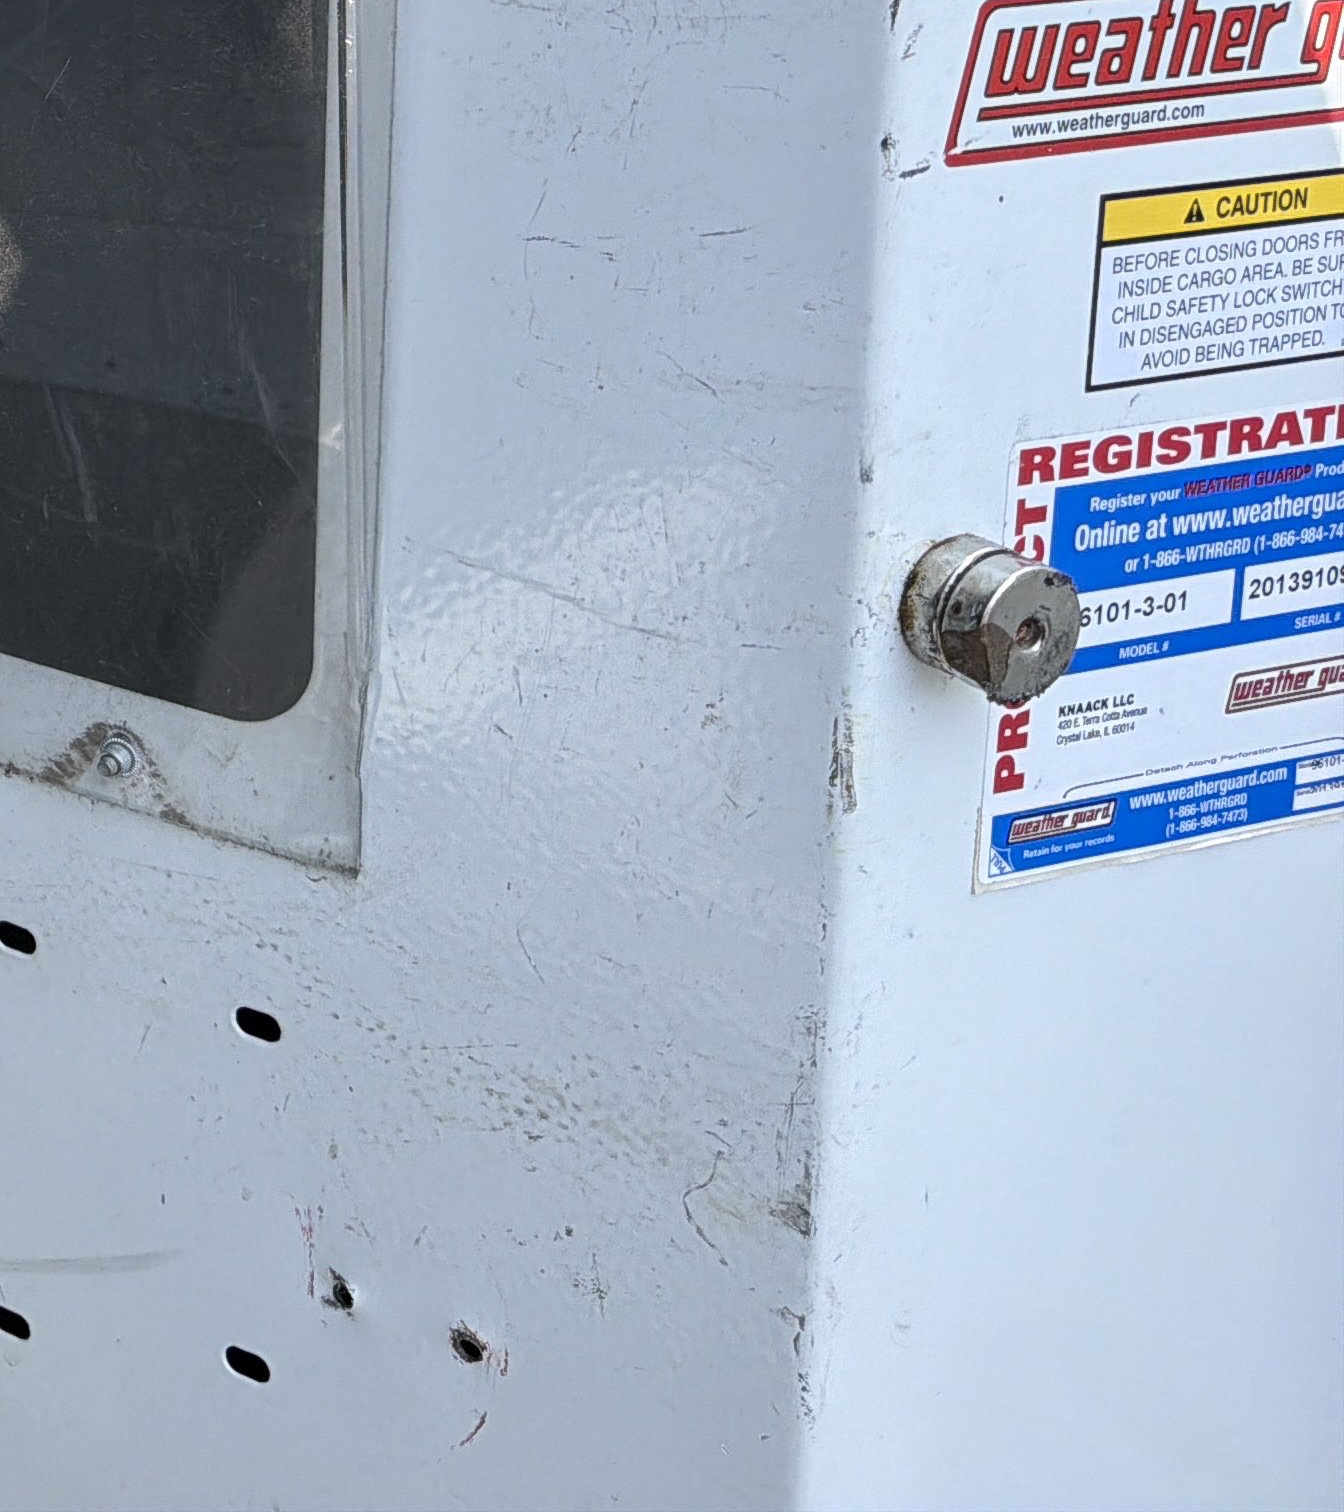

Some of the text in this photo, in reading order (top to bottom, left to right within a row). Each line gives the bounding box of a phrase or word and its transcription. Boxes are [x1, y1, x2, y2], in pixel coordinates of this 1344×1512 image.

[1011, 104, 1205, 139] www.weatherguard.com
[1216, 187, 1309, 219] CAUTION
[1112, 249, 1181, 274] BEFORE
[1185, 240, 1257, 265] CLOSING
[1262, 232, 1319, 257] DOORS
[1118, 275, 1173, 299] INSIDE
[1177, 268, 1237, 291] CARGO
[1240, 262, 1288, 284] AREA.
[1292, 257, 1313, 276] BE
[1111, 277, 1343, 325] CHILD SAFETY LOCK SWITCH
[1118, 330, 1135, 349] IN
[1139, 315, 1248, 346] DISENGAGED
[1252, 305, 1328, 331] POSITION
[1140, 347, 1191, 371] AVOID
[1195, 339, 1245, 363] BEING
[1249, 329, 1326, 356] TRAPPED.
[1090, 491, 1147, 513] Register
[1150, 488, 1182, 506] your
[1184, 473, 1251, 499] WEATHER
[1074, 518, 1140, 552] Online
[1146, 513, 1167, 540] at
[1124, 558, 1140, 574] or
[1142, 536, 1251, 570] 1-866-WTHRGRD
[1294, 613, 1332, 630] SERIAL
[1118, 640, 1170, 659] MODEL #
[1233, 666, 1314, 702] weather
[1058, 693, 1135, 718] KNAACK LLC
[1056, 730, 1082, 746] Crystal
[1145, 746, 1279, 777] Detach Along Perforation
[1129, 766, 1288, 810] www.weatherguard.com
[1012, 812, 1068, 837] weather
[1165, 809, 1249, 839] (1-866-984-7473)
[1168, 793, 1248, 821] 1-866-WTHRGRD
[1050, 844, 1063, 854] for
[1064, 840, 1083, 852] your
[1084, 833, 1115, 847] records
